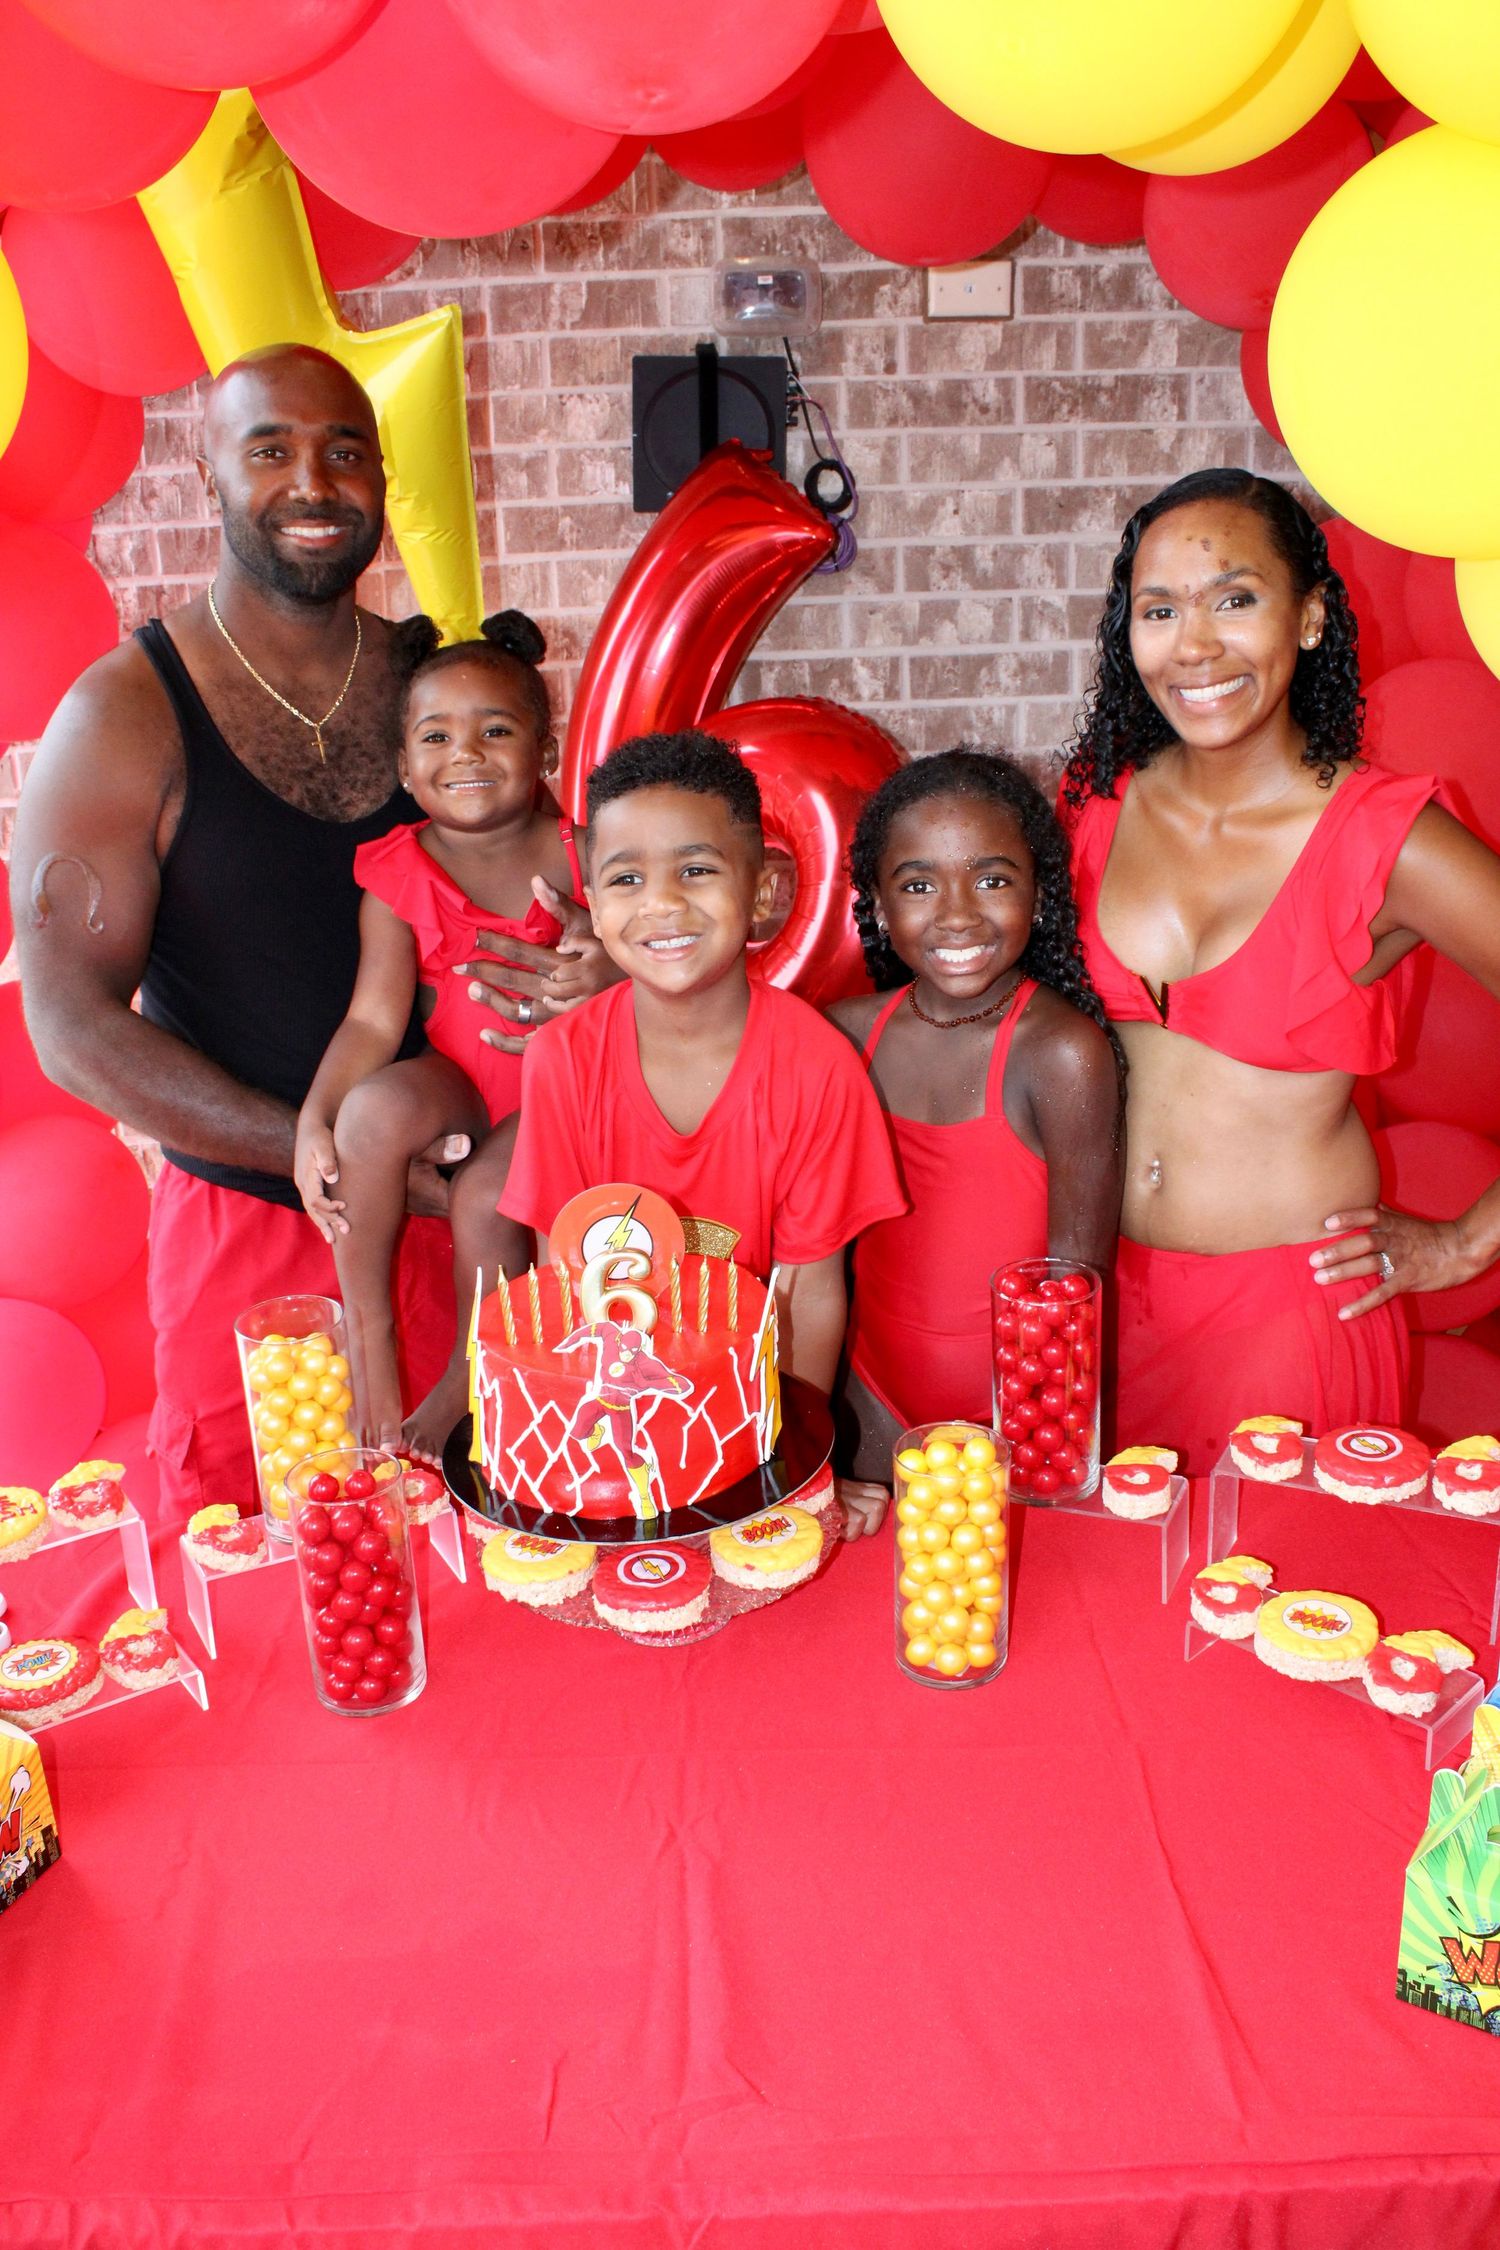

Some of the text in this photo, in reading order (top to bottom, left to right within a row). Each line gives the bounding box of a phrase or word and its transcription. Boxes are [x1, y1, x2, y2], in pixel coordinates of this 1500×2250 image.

[562, 438, 906, 1006] 6
[581, 1247, 659, 1336] 6
[742, 1516, 791, 1543] BOOM!
[1289, 1610, 1348, 1632] BOOM!
[1439, 1936, 1500, 1988] W
